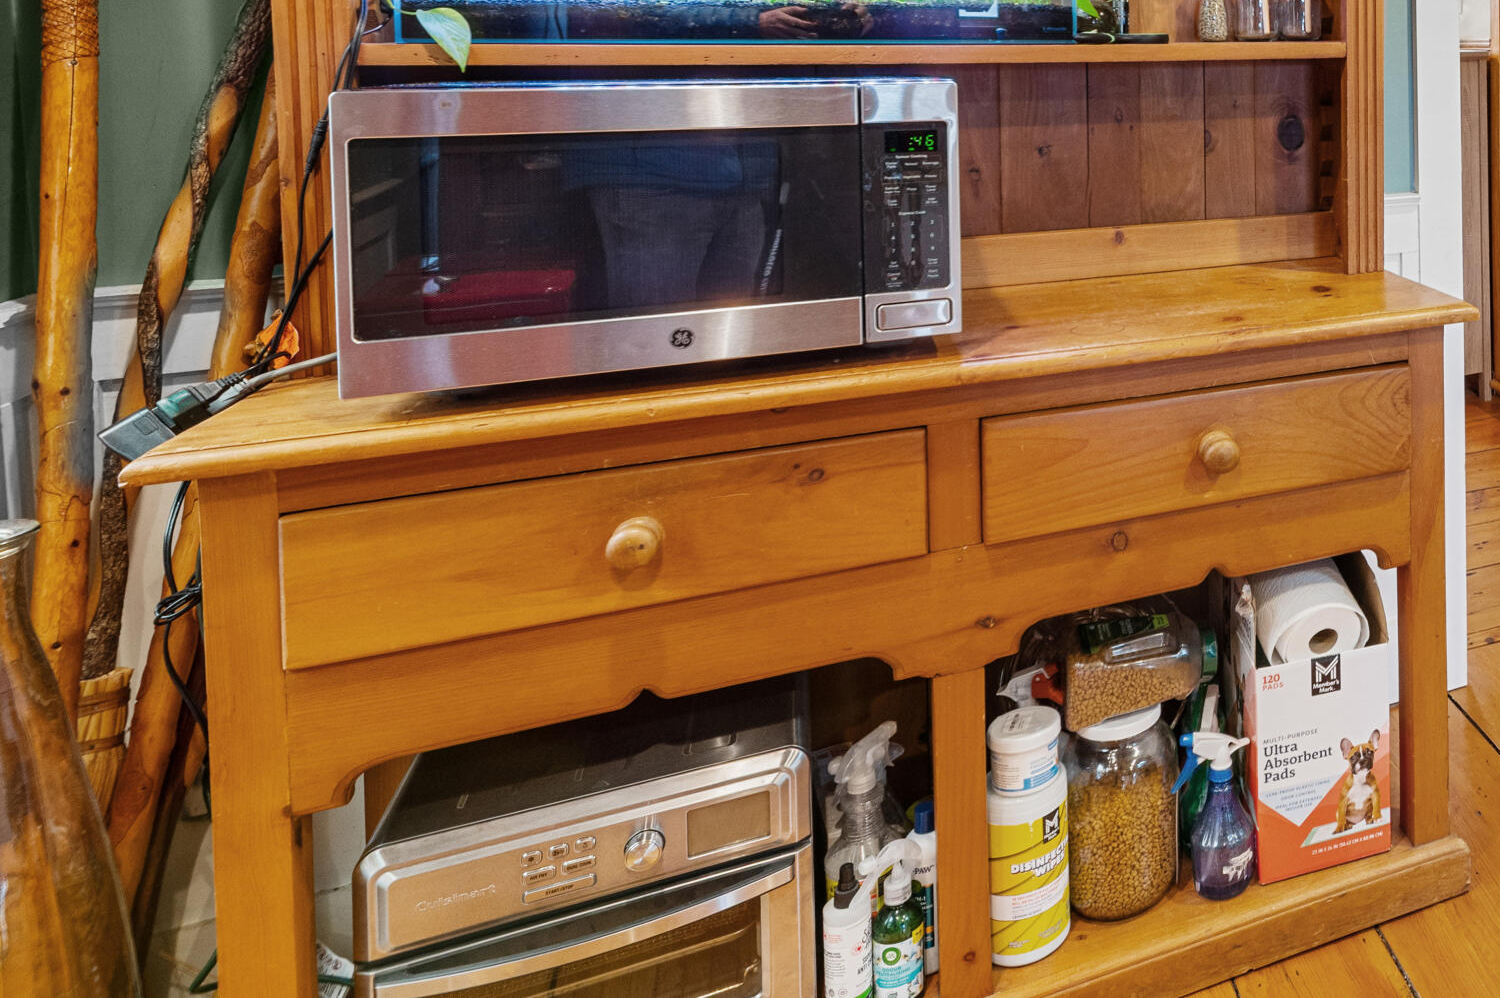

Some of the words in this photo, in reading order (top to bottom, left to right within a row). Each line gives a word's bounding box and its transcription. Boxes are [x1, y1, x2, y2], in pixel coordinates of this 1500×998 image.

[1262, 673, 1280, 684] 120
[1262, 682, 1285, 691] PADS
[1263, 728, 1319, 744] MULTI-PURPOSE
[1264, 743, 1298, 757] Ultra
[1264, 746, 1333, 771] Absorbent
[1264, 768, 1296, 784] Pads
